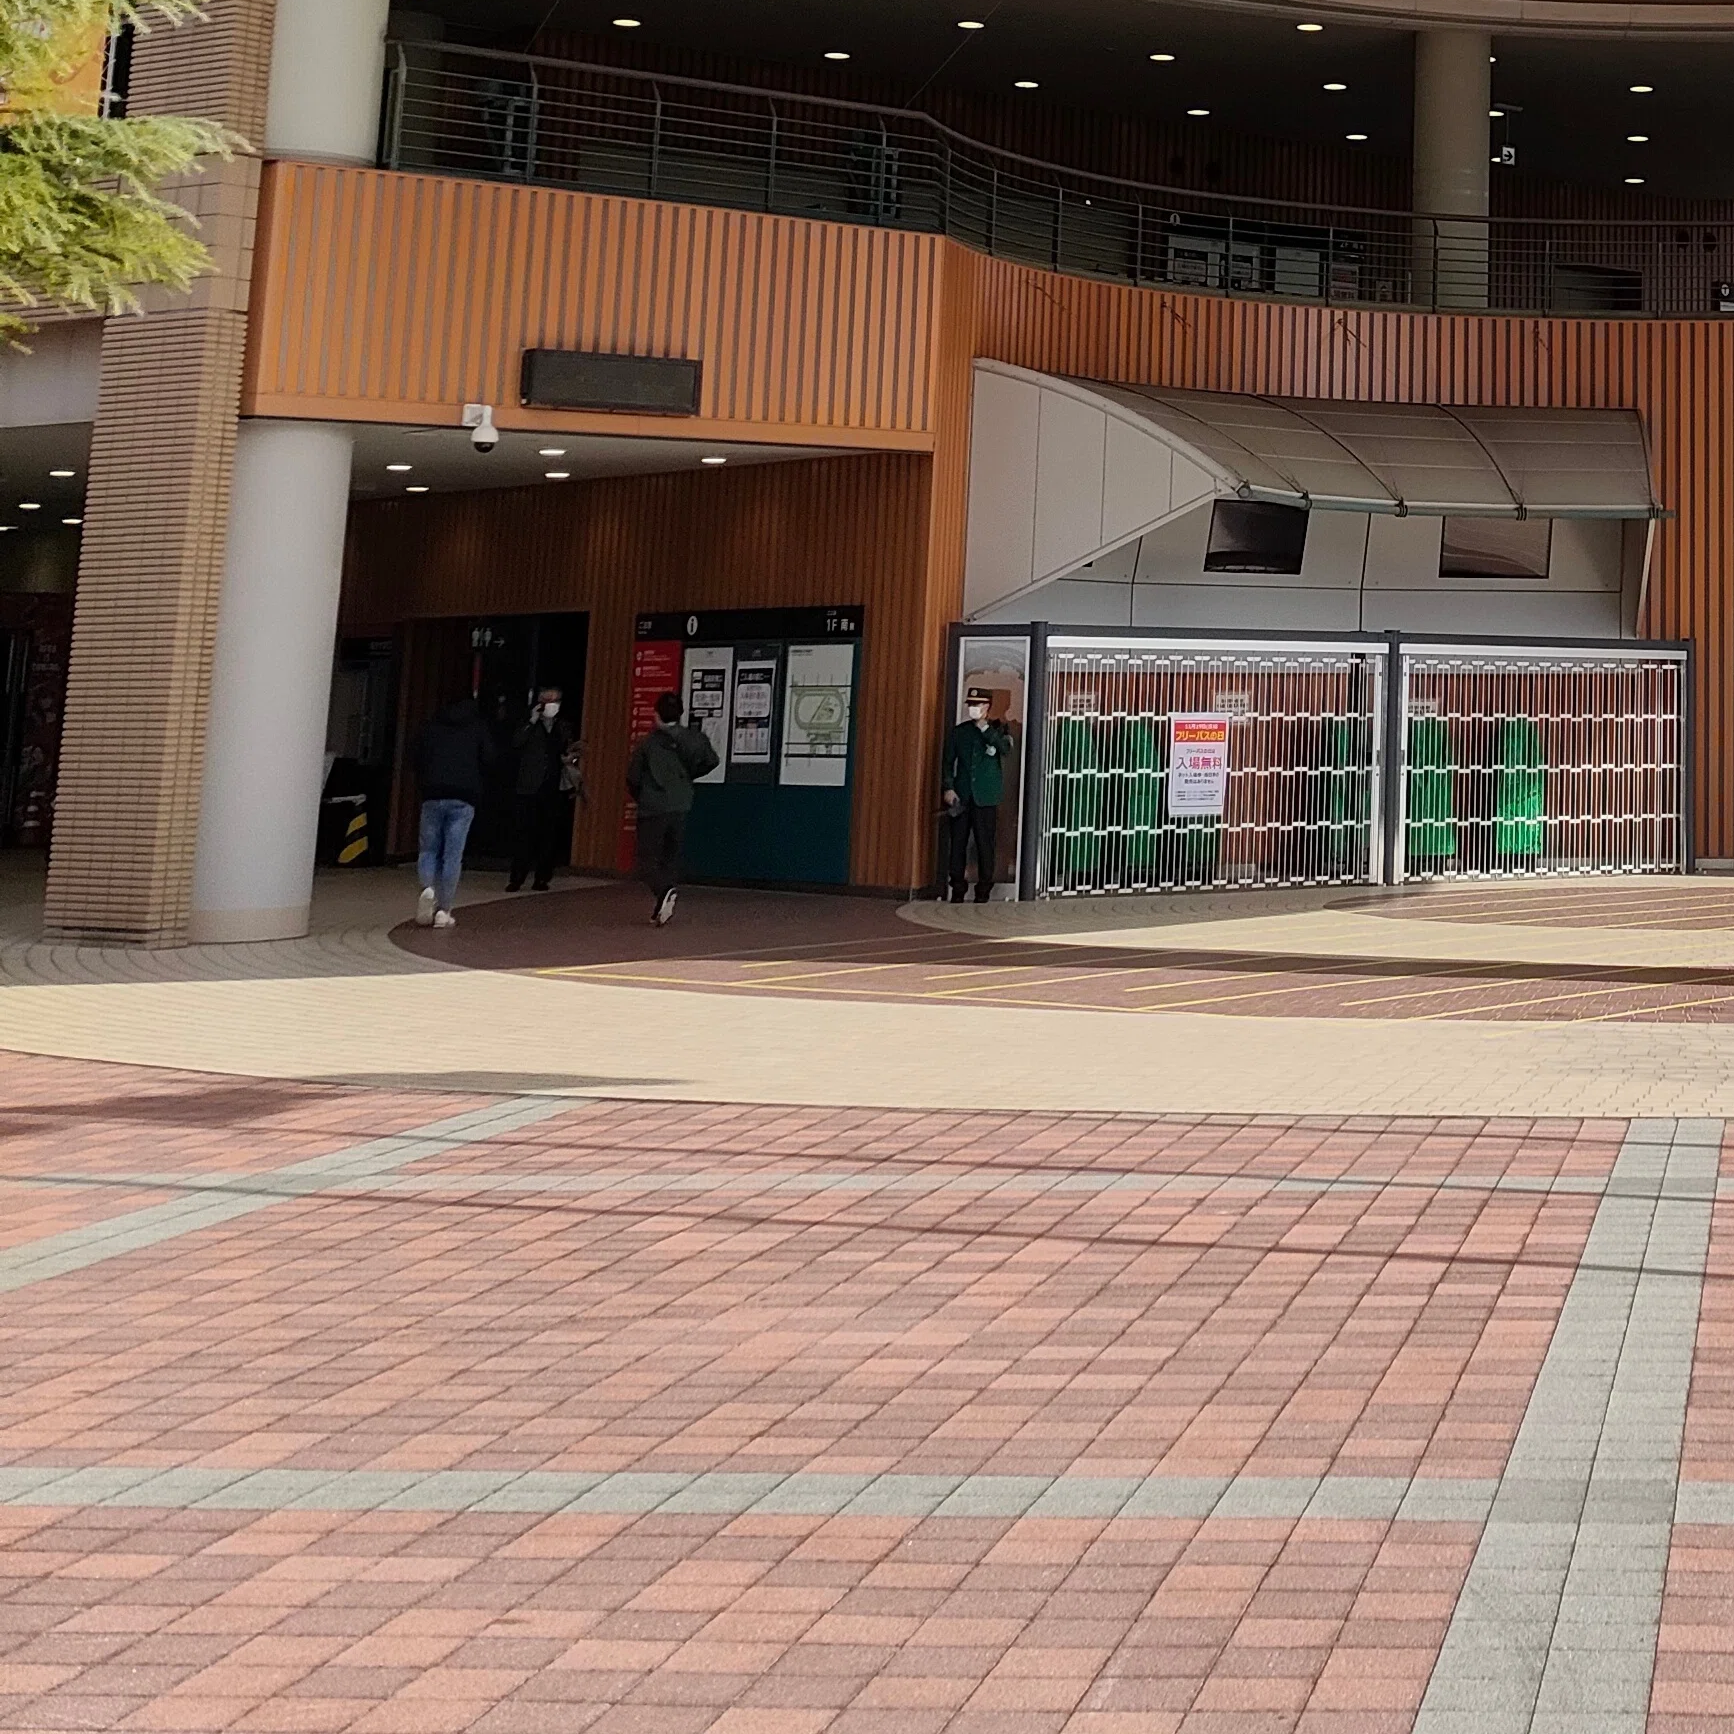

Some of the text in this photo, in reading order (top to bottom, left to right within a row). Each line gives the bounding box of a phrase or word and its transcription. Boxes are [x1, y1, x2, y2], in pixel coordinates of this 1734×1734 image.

[826, 618, 838, 632] 1F
[1175, 730, 1225, 741] フリーパスの日
[1175, 756, 1222, 770] 入場無料
